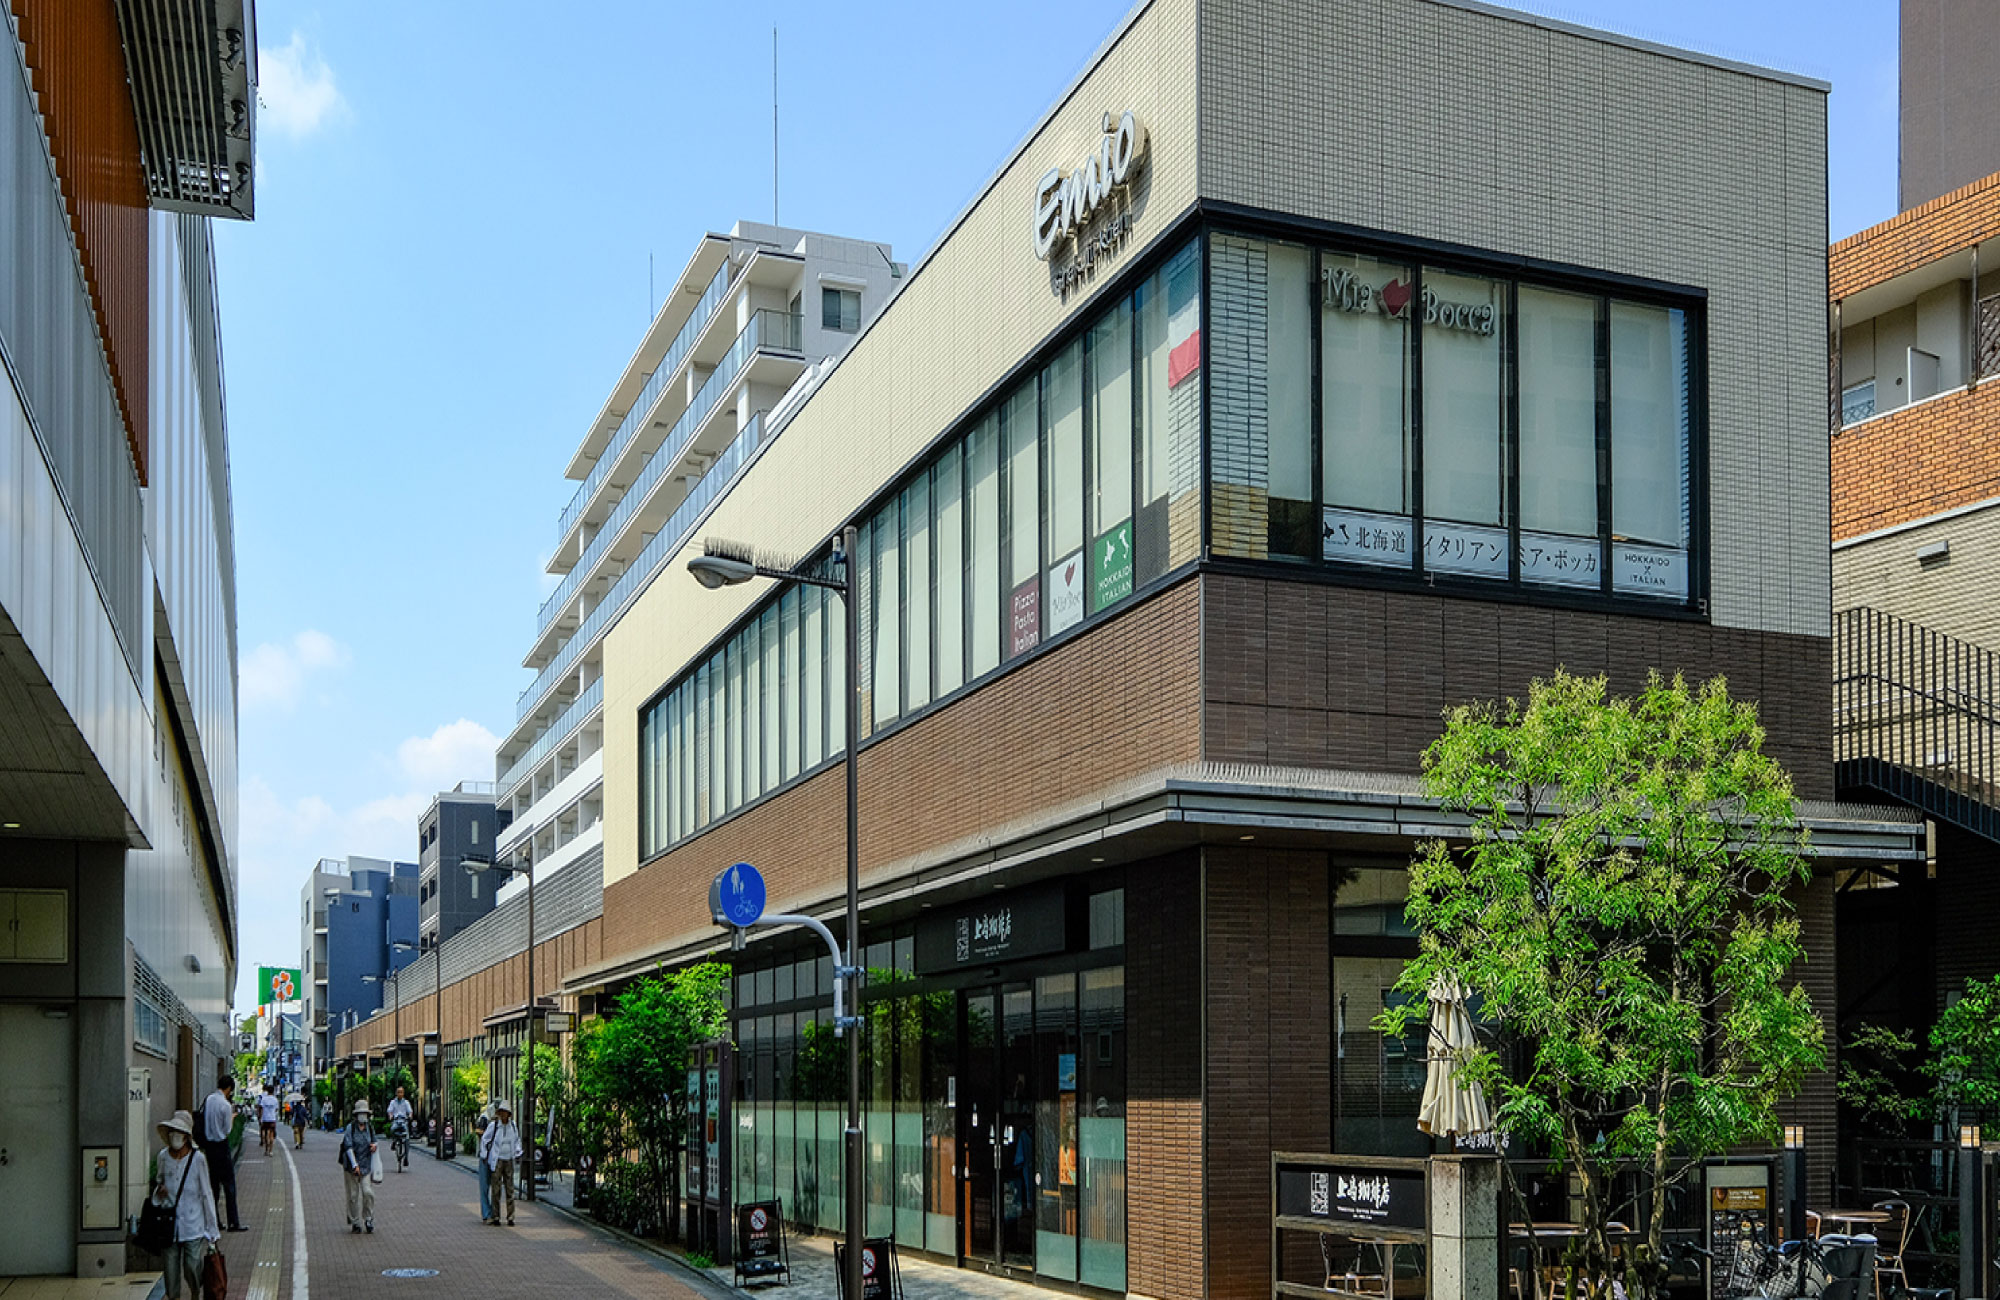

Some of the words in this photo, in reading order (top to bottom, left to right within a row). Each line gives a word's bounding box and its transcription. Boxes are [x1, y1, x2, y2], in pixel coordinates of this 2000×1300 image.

[1034, 109, 1137, 261] Emio
[1322, 267, 1373, 312] Mia
[1422, 285, 1494, 333] Bocca
[1356, 527, 1406, 553] 北海道
[1423, 535, 1503, 562] イタリアン
[1624, 553, 1670, 567] HOKKAIDO
[1629, 575, 1666, 586] ITALIAN
